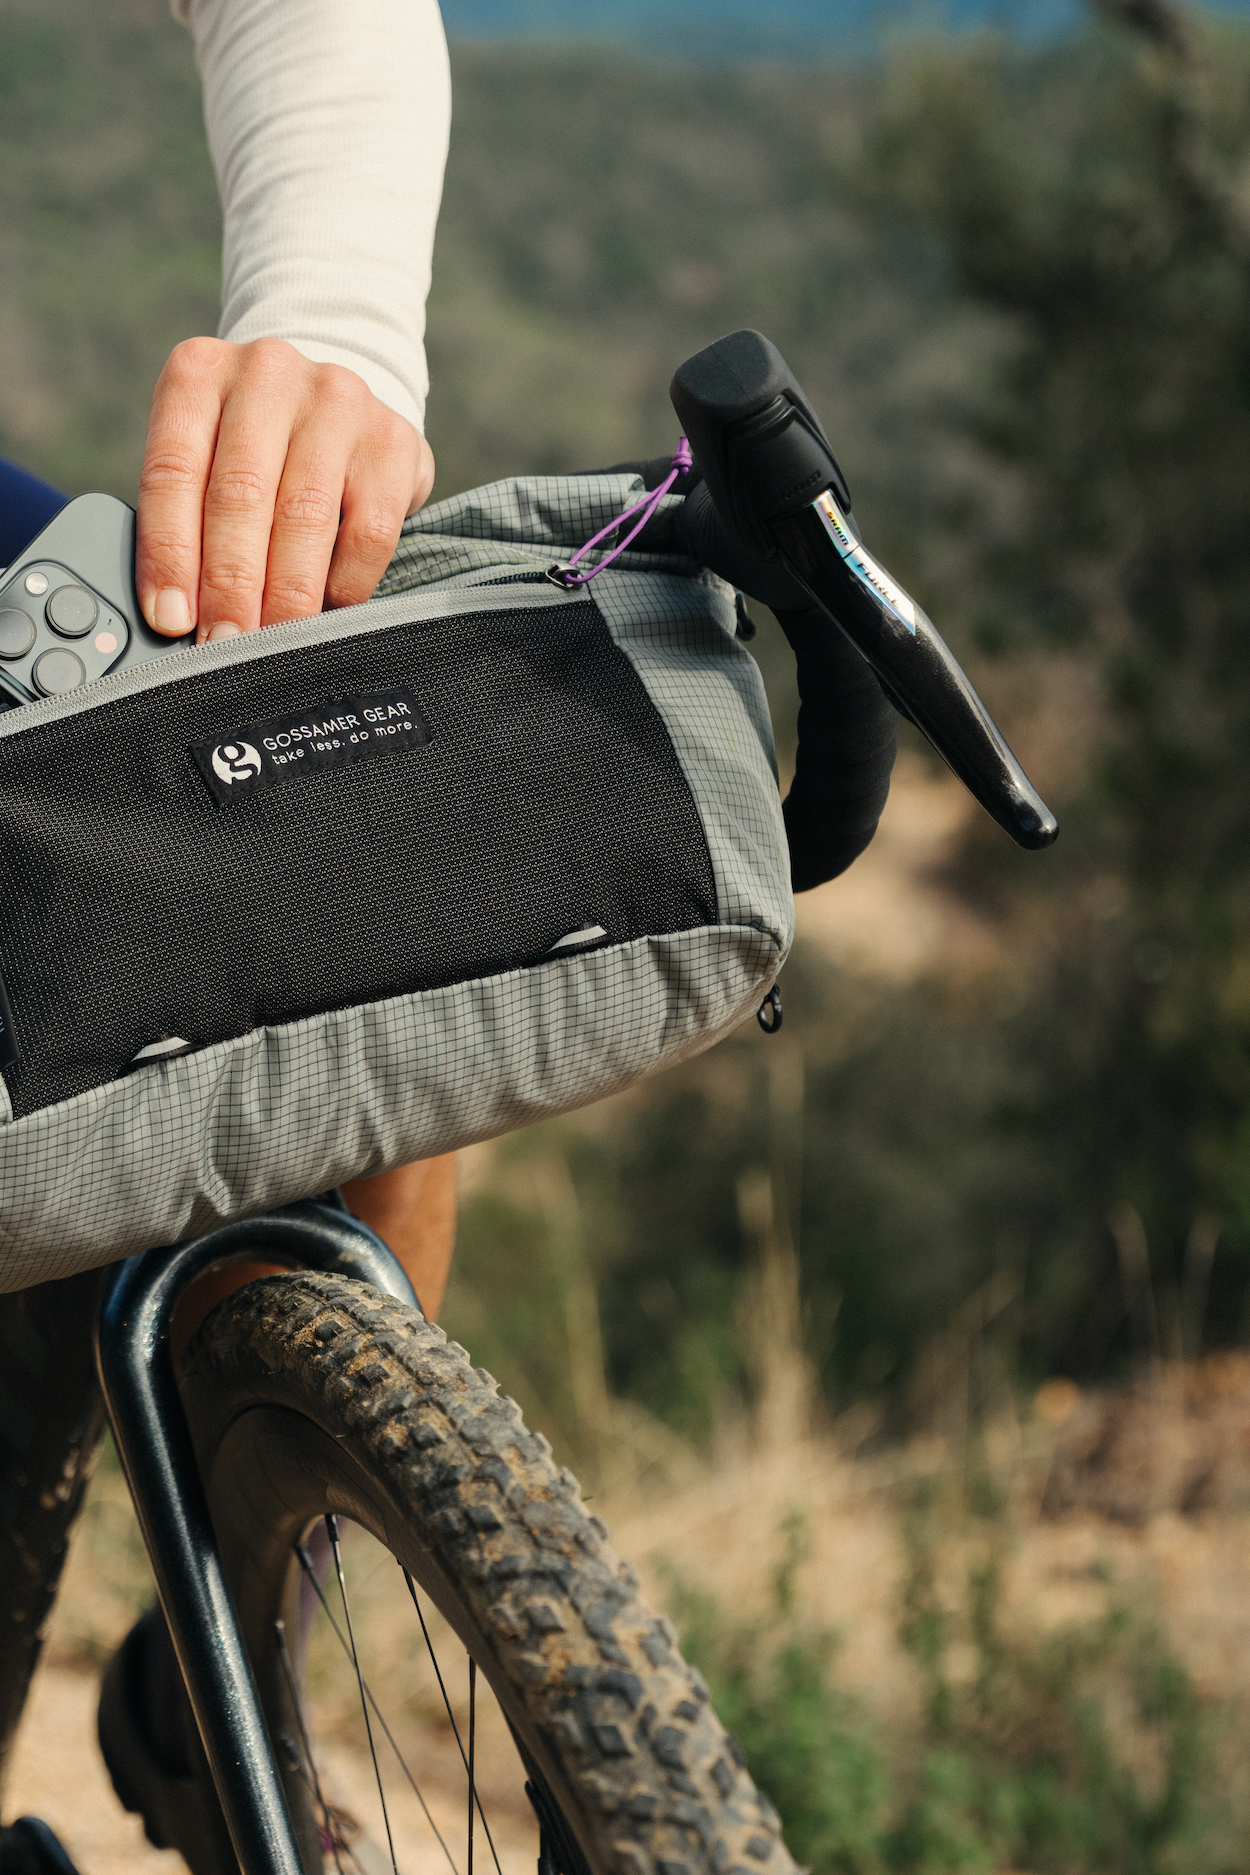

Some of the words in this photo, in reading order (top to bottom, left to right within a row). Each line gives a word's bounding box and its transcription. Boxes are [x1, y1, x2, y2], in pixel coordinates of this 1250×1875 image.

[826, 511, 849, 547] SRAM
[263, 714, 360, 751] GOSSAMER
[363, 702, 411, 723] GEAR
[272, 747, 305, 765] take
[311, 739, 346, 753] less.
[350, 729, 369, 744] do
[375, 721, 418, 737] more.
